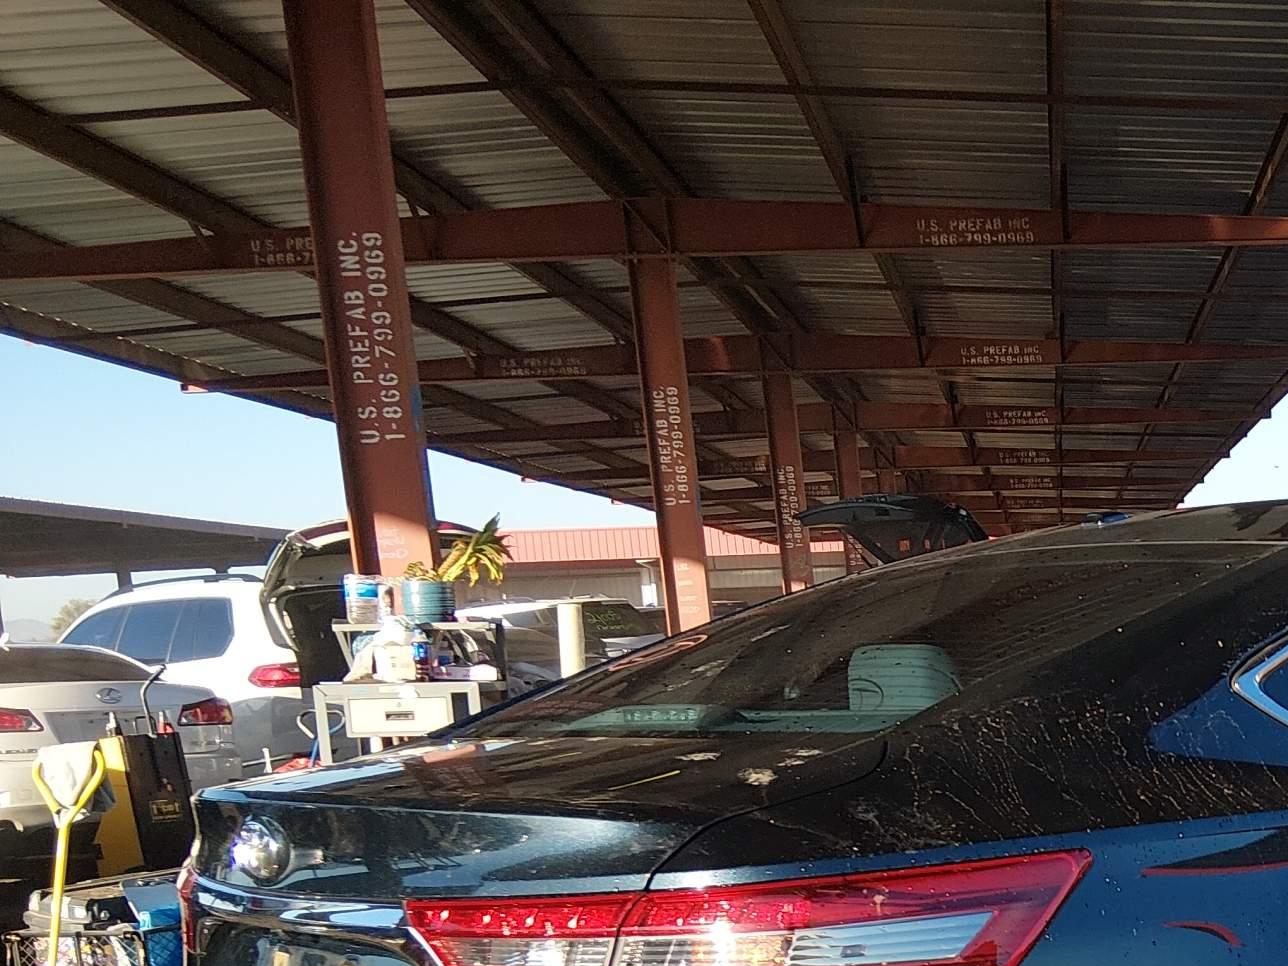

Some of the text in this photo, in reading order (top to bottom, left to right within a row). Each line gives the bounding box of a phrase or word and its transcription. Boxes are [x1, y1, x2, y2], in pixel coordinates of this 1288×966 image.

[916, 218, 943, 232] U.S.
[949, 217, 1002, 231] PREFAB
[919, 231, 1035, 246] 1-866-799-0969
[338, 231, 382, 444] U.S. PREFAB INC.
[362, 231, 406, 441] 1-866-799-0969
[983, 345, 1020, 355] PREFAB
[652, 385, 678, 507] U.S. PREFAB INC.
[666, 385, 692, 505] 1-866-799-0969
[779, 488, 792, 527] PREFAB
